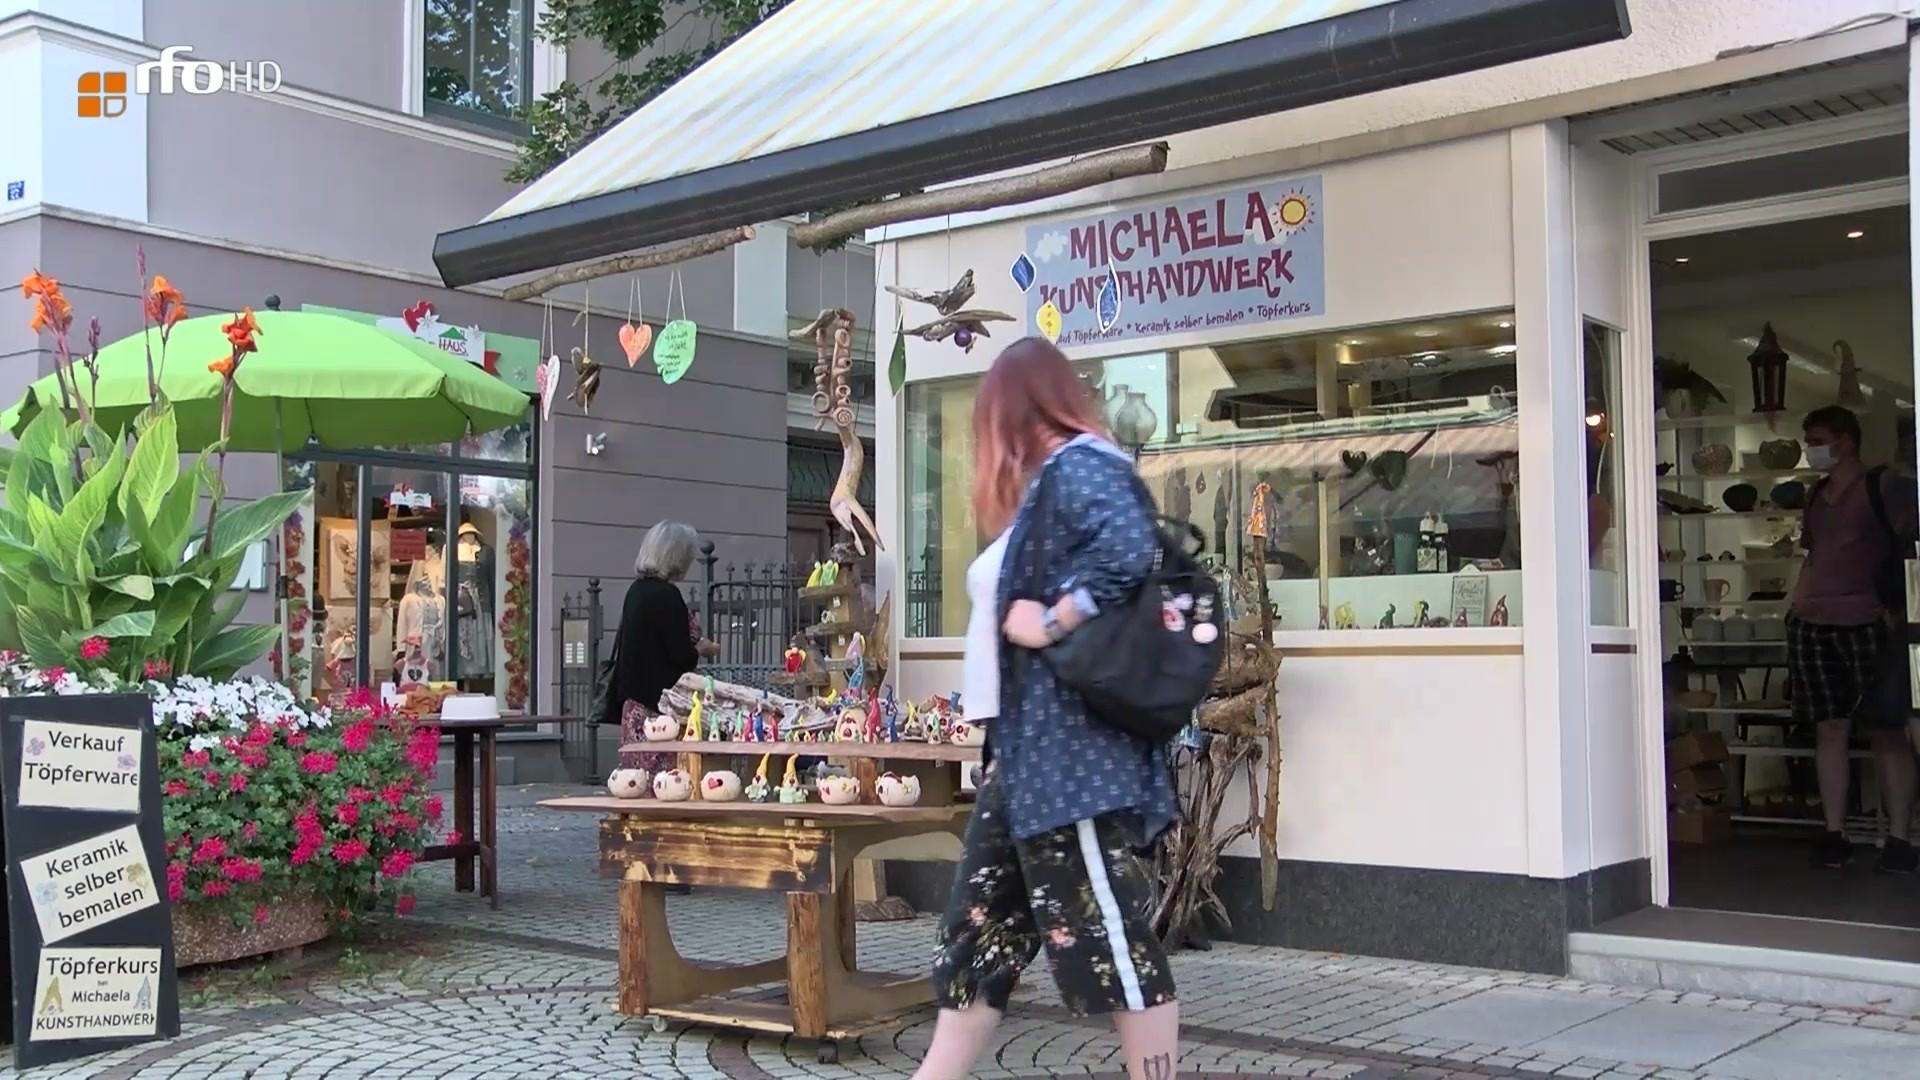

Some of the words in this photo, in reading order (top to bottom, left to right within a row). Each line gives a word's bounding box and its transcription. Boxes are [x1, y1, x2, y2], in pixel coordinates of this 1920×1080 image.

[1070, 191, 1275, 269] MICHAELA
[1134, 317, 1171, 334] Keramik
[1174, 315, 1203, 329] selber
[1206, 309, 1244, 325] bemalen
[1257, 301, 1311, 320] Töpferkurs
[438, 338, 468, 354] HAUS
[48, 730, 125, 752] Verkauf
[24, 762, 138, 786] Töpferware
[46, 839, 129, 878] Keramik
[64, 866, 125, 899] selber
[58, 888, 144, 929] bemalen
[46, 956, 158, 980] Töpferkurs
[71, 989, 131, 1003] Michaela
